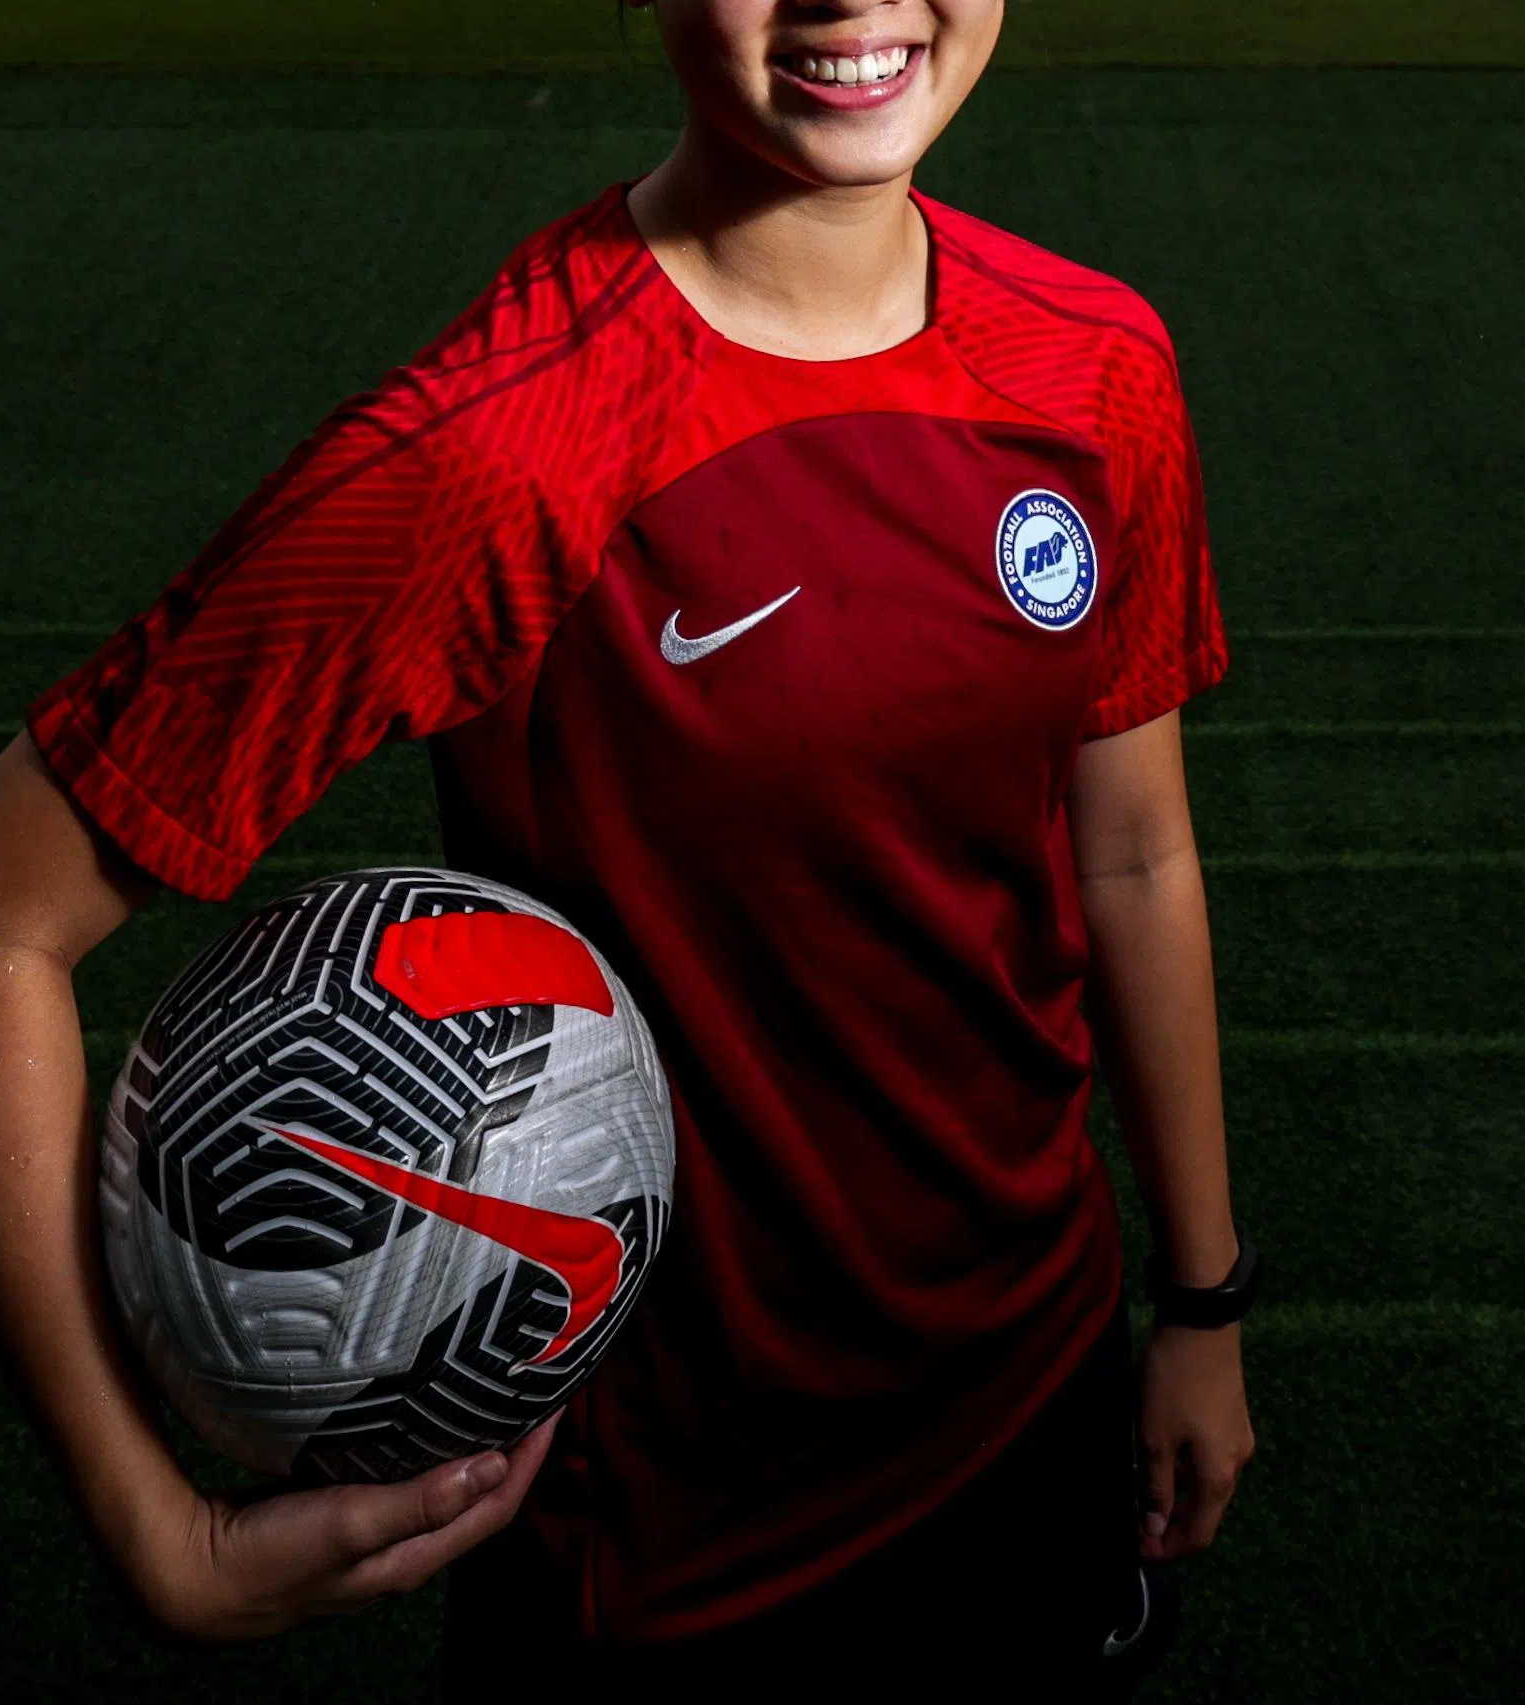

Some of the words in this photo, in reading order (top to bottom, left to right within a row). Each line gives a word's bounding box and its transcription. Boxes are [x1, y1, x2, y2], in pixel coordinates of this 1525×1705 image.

[1004, 512, 1023, 584] FOOTBALL
[1027, 501, 1087, 563] ASSOCIATION
[1026, 584, 1086, 618] SINGAPORE
